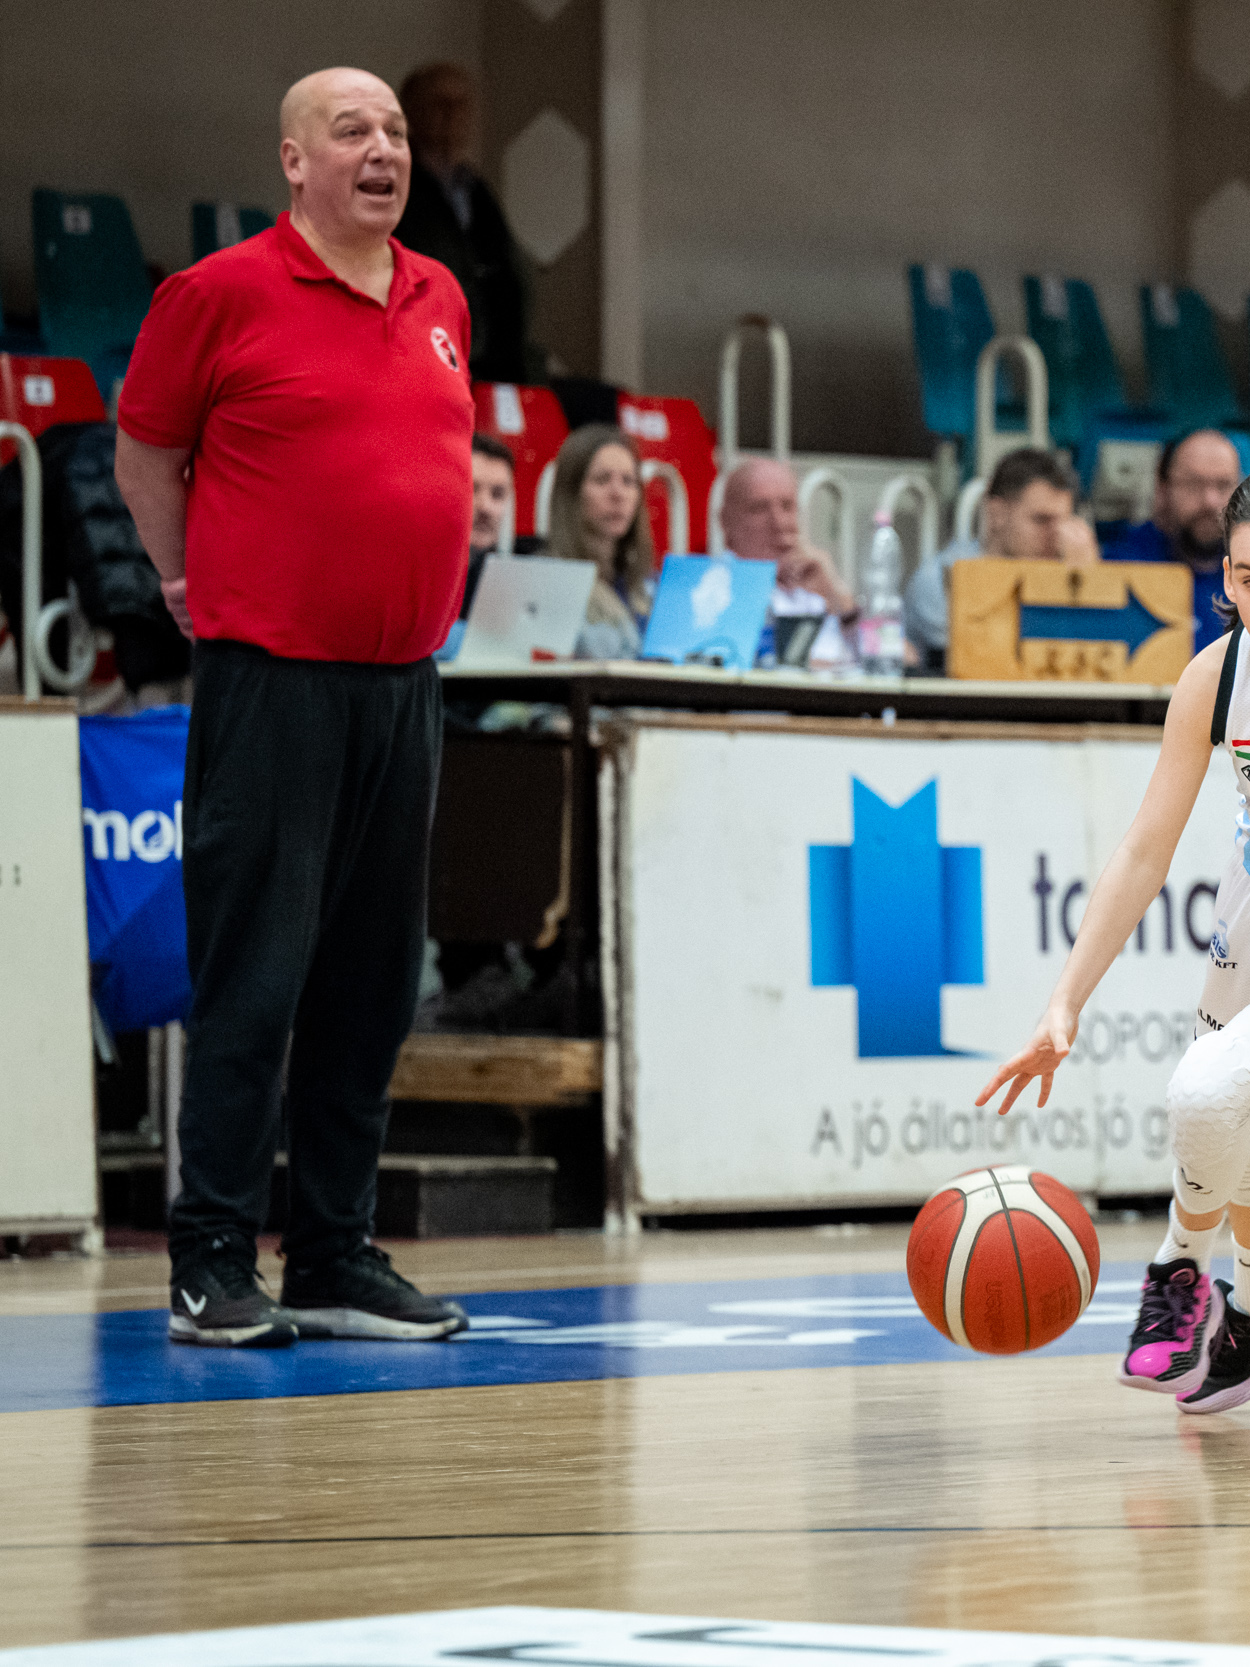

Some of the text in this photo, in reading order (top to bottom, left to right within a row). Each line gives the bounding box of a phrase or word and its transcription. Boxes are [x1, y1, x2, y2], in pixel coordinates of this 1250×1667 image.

[82, 800, 183, 864] mol
[811, 1104, 843, 1156] A
[851, 1097, 891, 1169] jó
